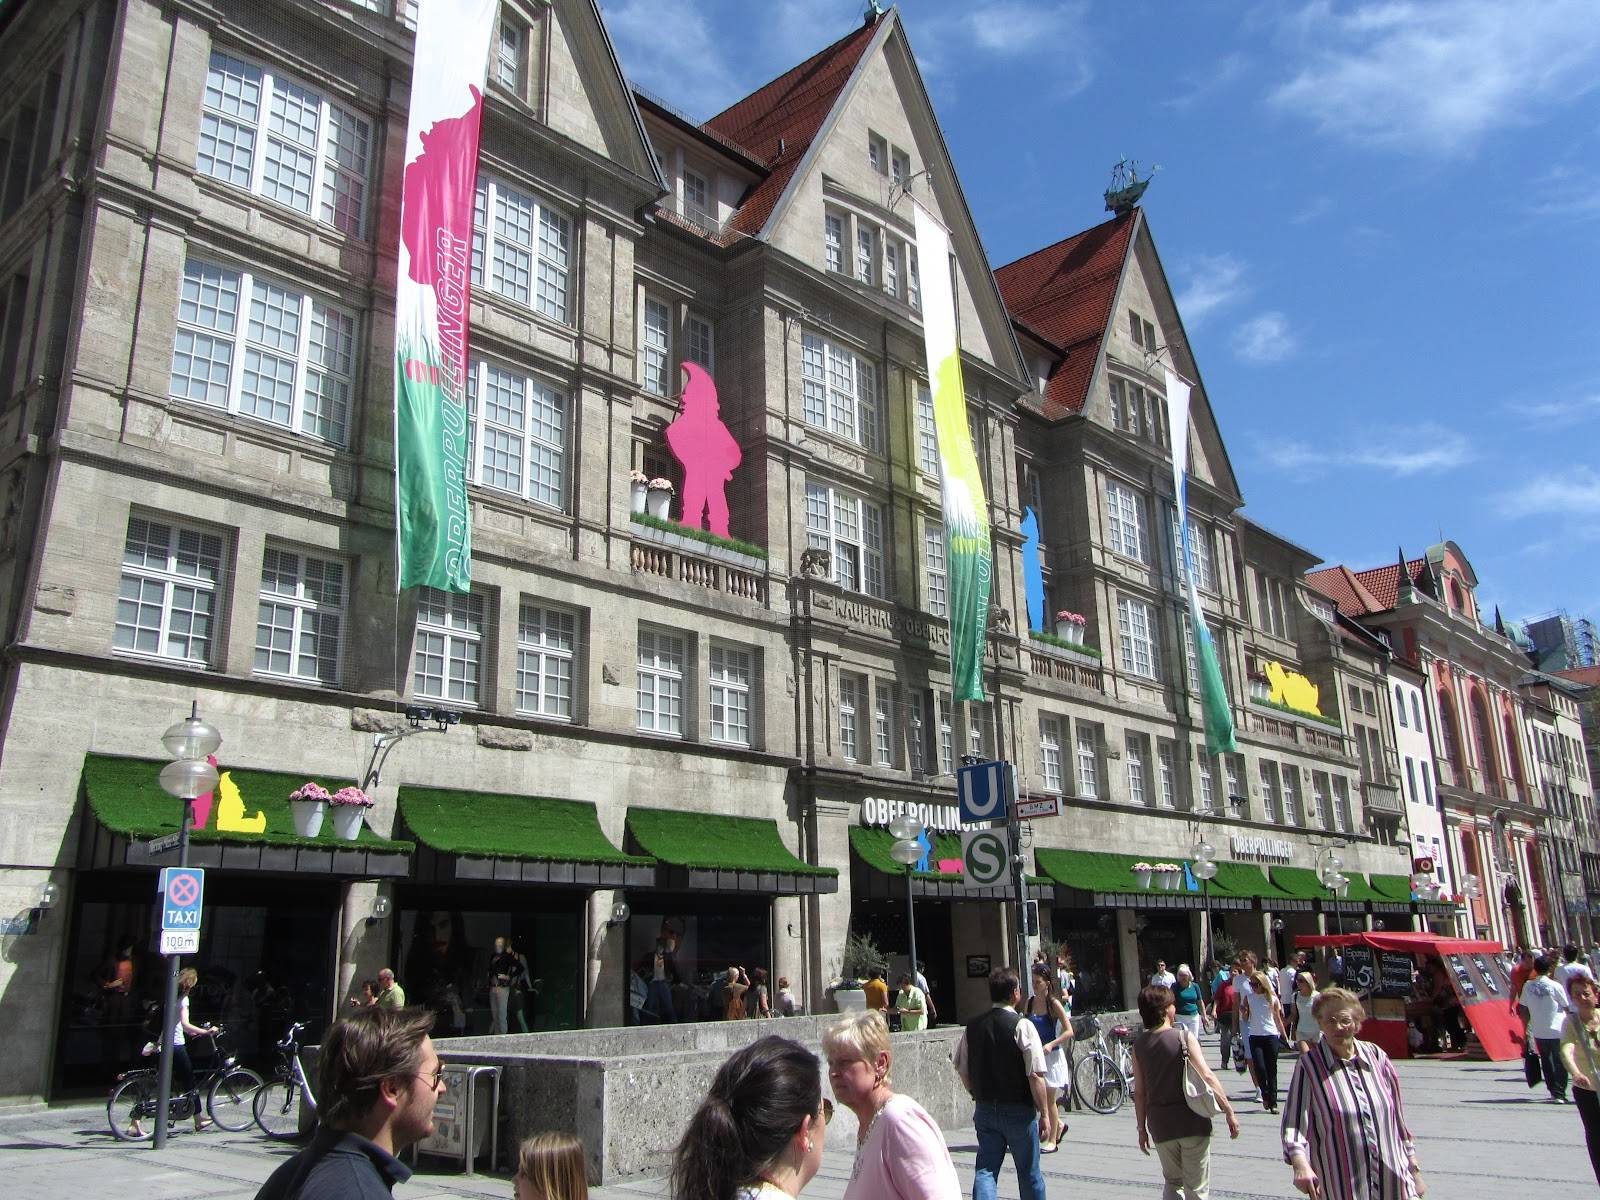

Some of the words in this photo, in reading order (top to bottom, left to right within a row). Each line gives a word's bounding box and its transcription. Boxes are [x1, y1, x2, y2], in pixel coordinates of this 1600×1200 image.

[835, 600, 903, 631] KAUFHAUS
[962, 766, 999, 817] U
[971, 838, 1000, 880] S
[1232, 835, 1294, 859] OBERPOLLINGER
[167, 910, 198, 924] TAXI
